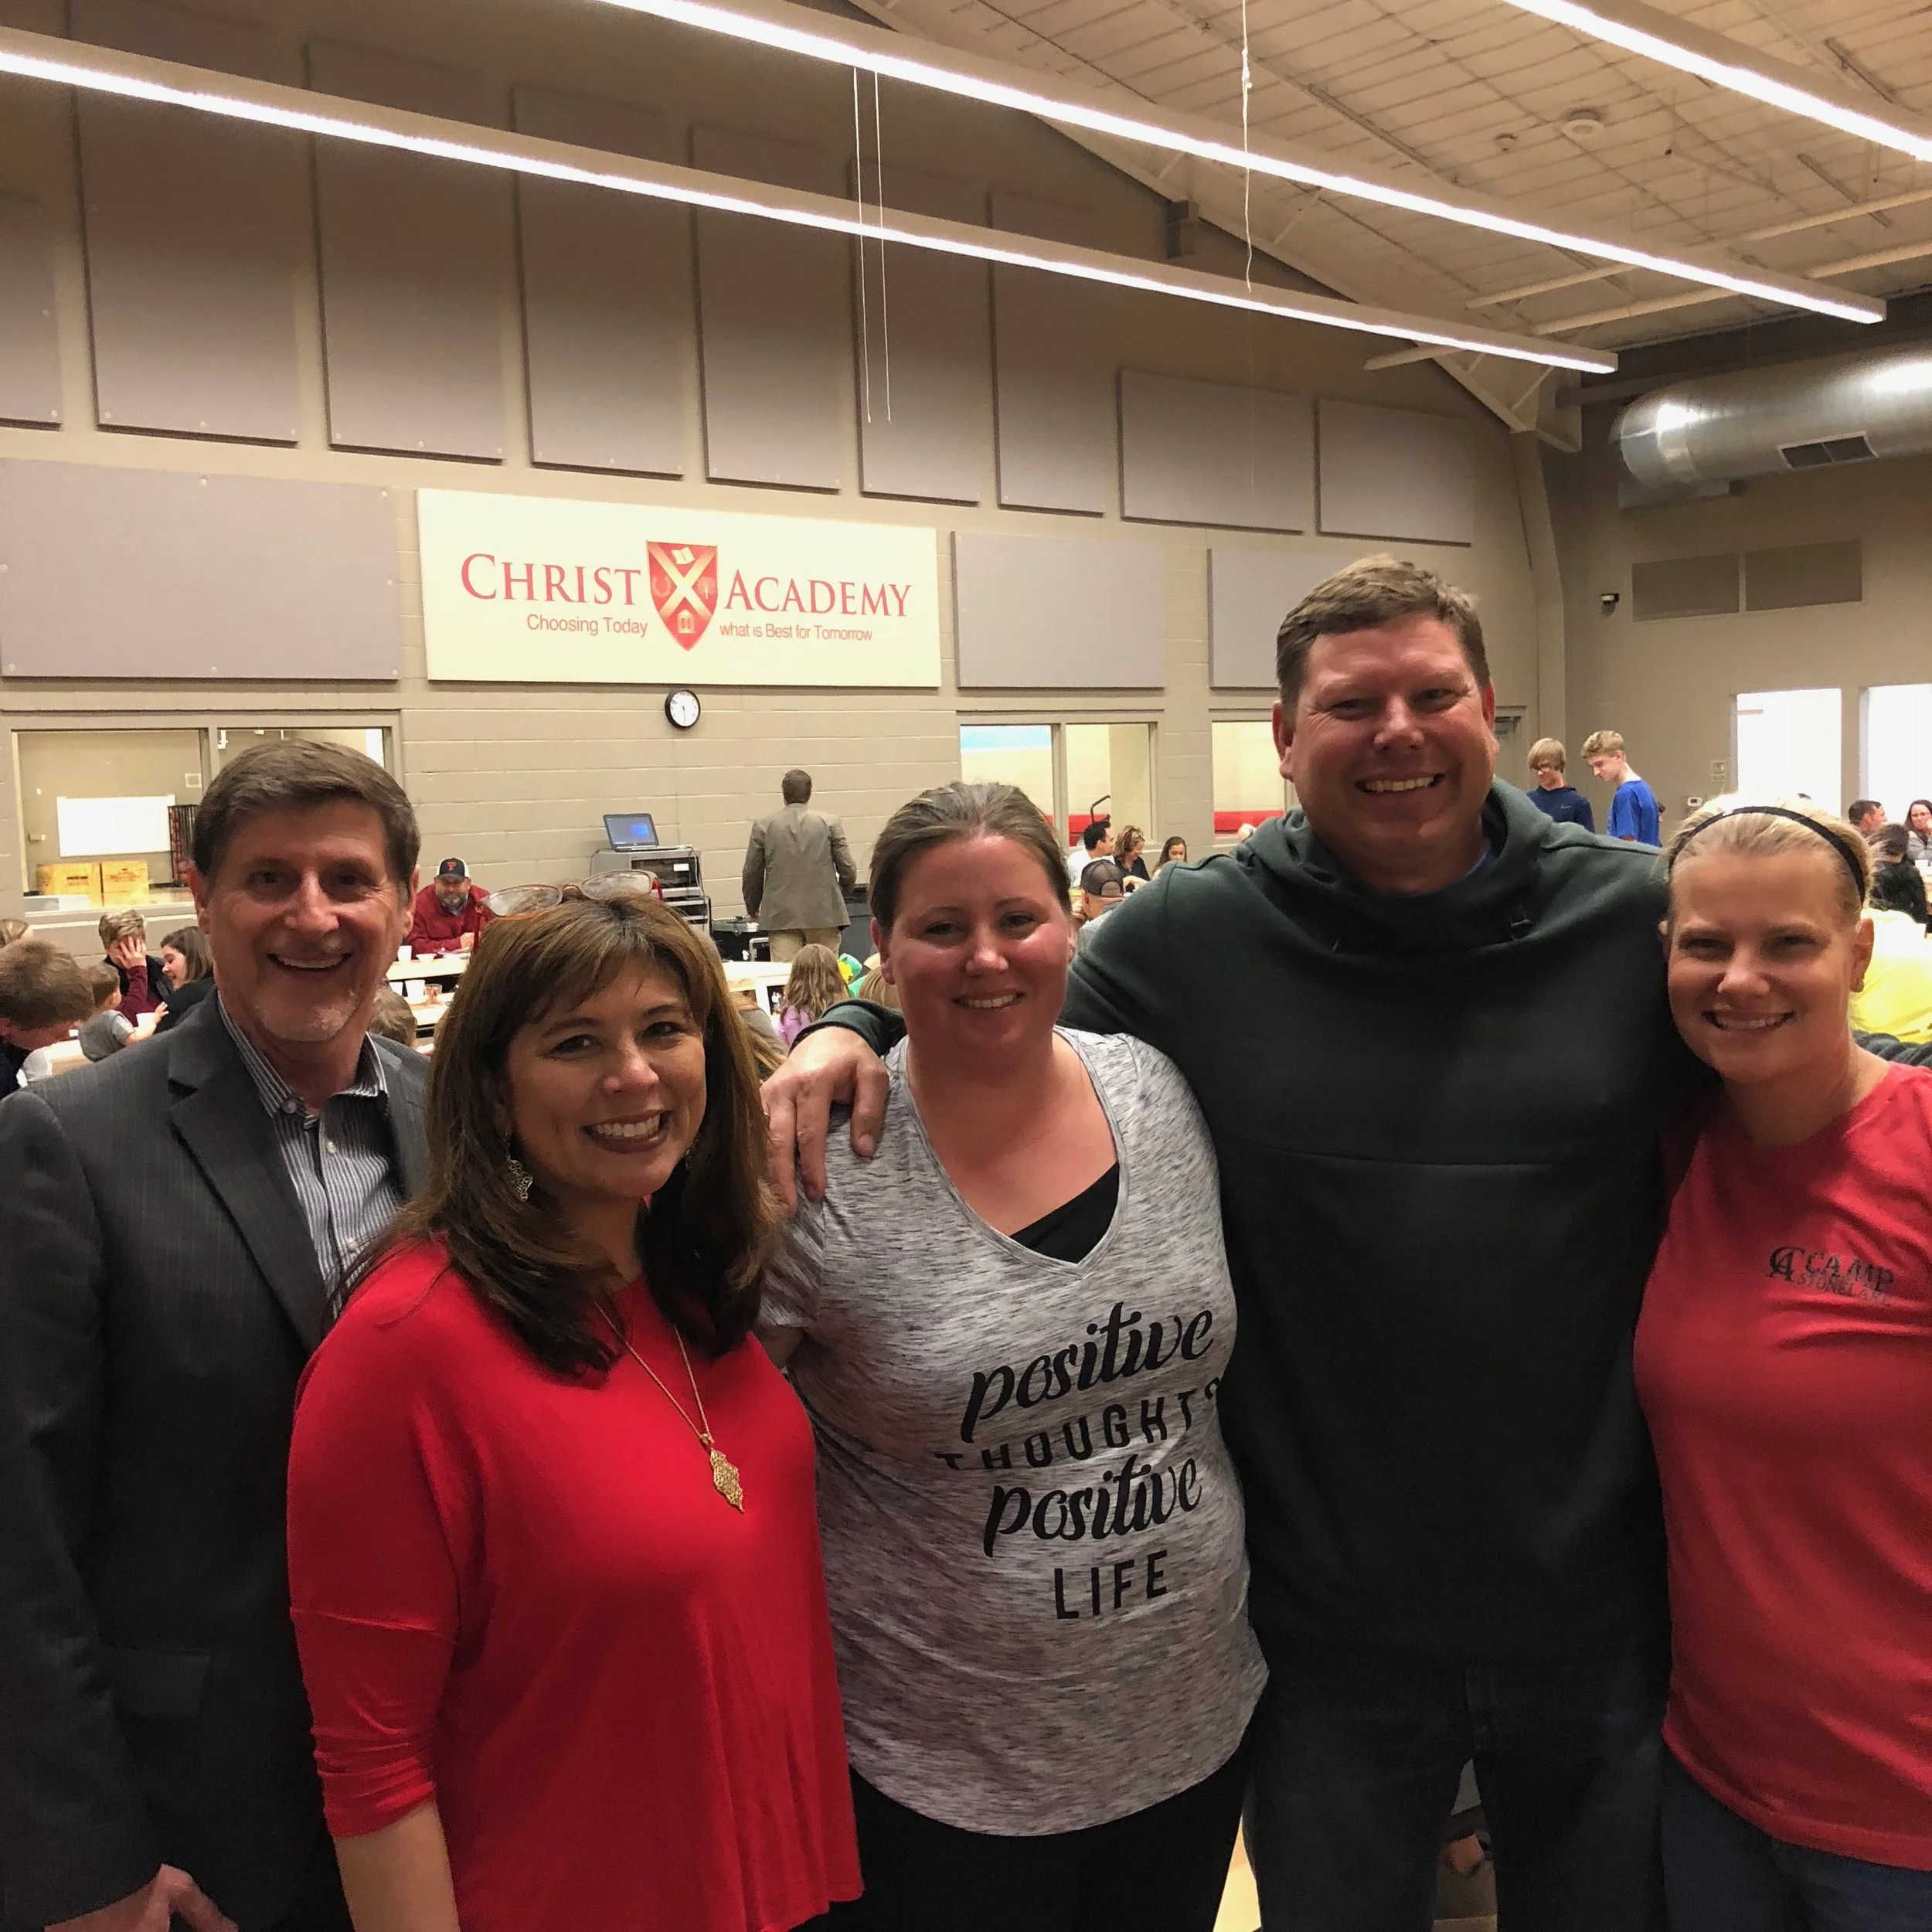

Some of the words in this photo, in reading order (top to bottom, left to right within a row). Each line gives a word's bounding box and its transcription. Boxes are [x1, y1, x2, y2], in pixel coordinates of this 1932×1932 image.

[461, 553, 641, 605] CHRIST
[723, 569, 912, 617] ACADEMY
[526, 614, 598, 636] Choosing
[603, 617, 648, 638] Today
[719, 622, 750, 638] what
[753, 624, 763, 638] is
[766, 623, 794, 639] Best
[795, 624, 811, 639] for
[813, 624, 872, 641] Tomorrow
[961, 1301, 1213, 1443] positive
[984, 1454, 1202, 1557] positive
[1054, 1550, 1167, 1619] LIFE
